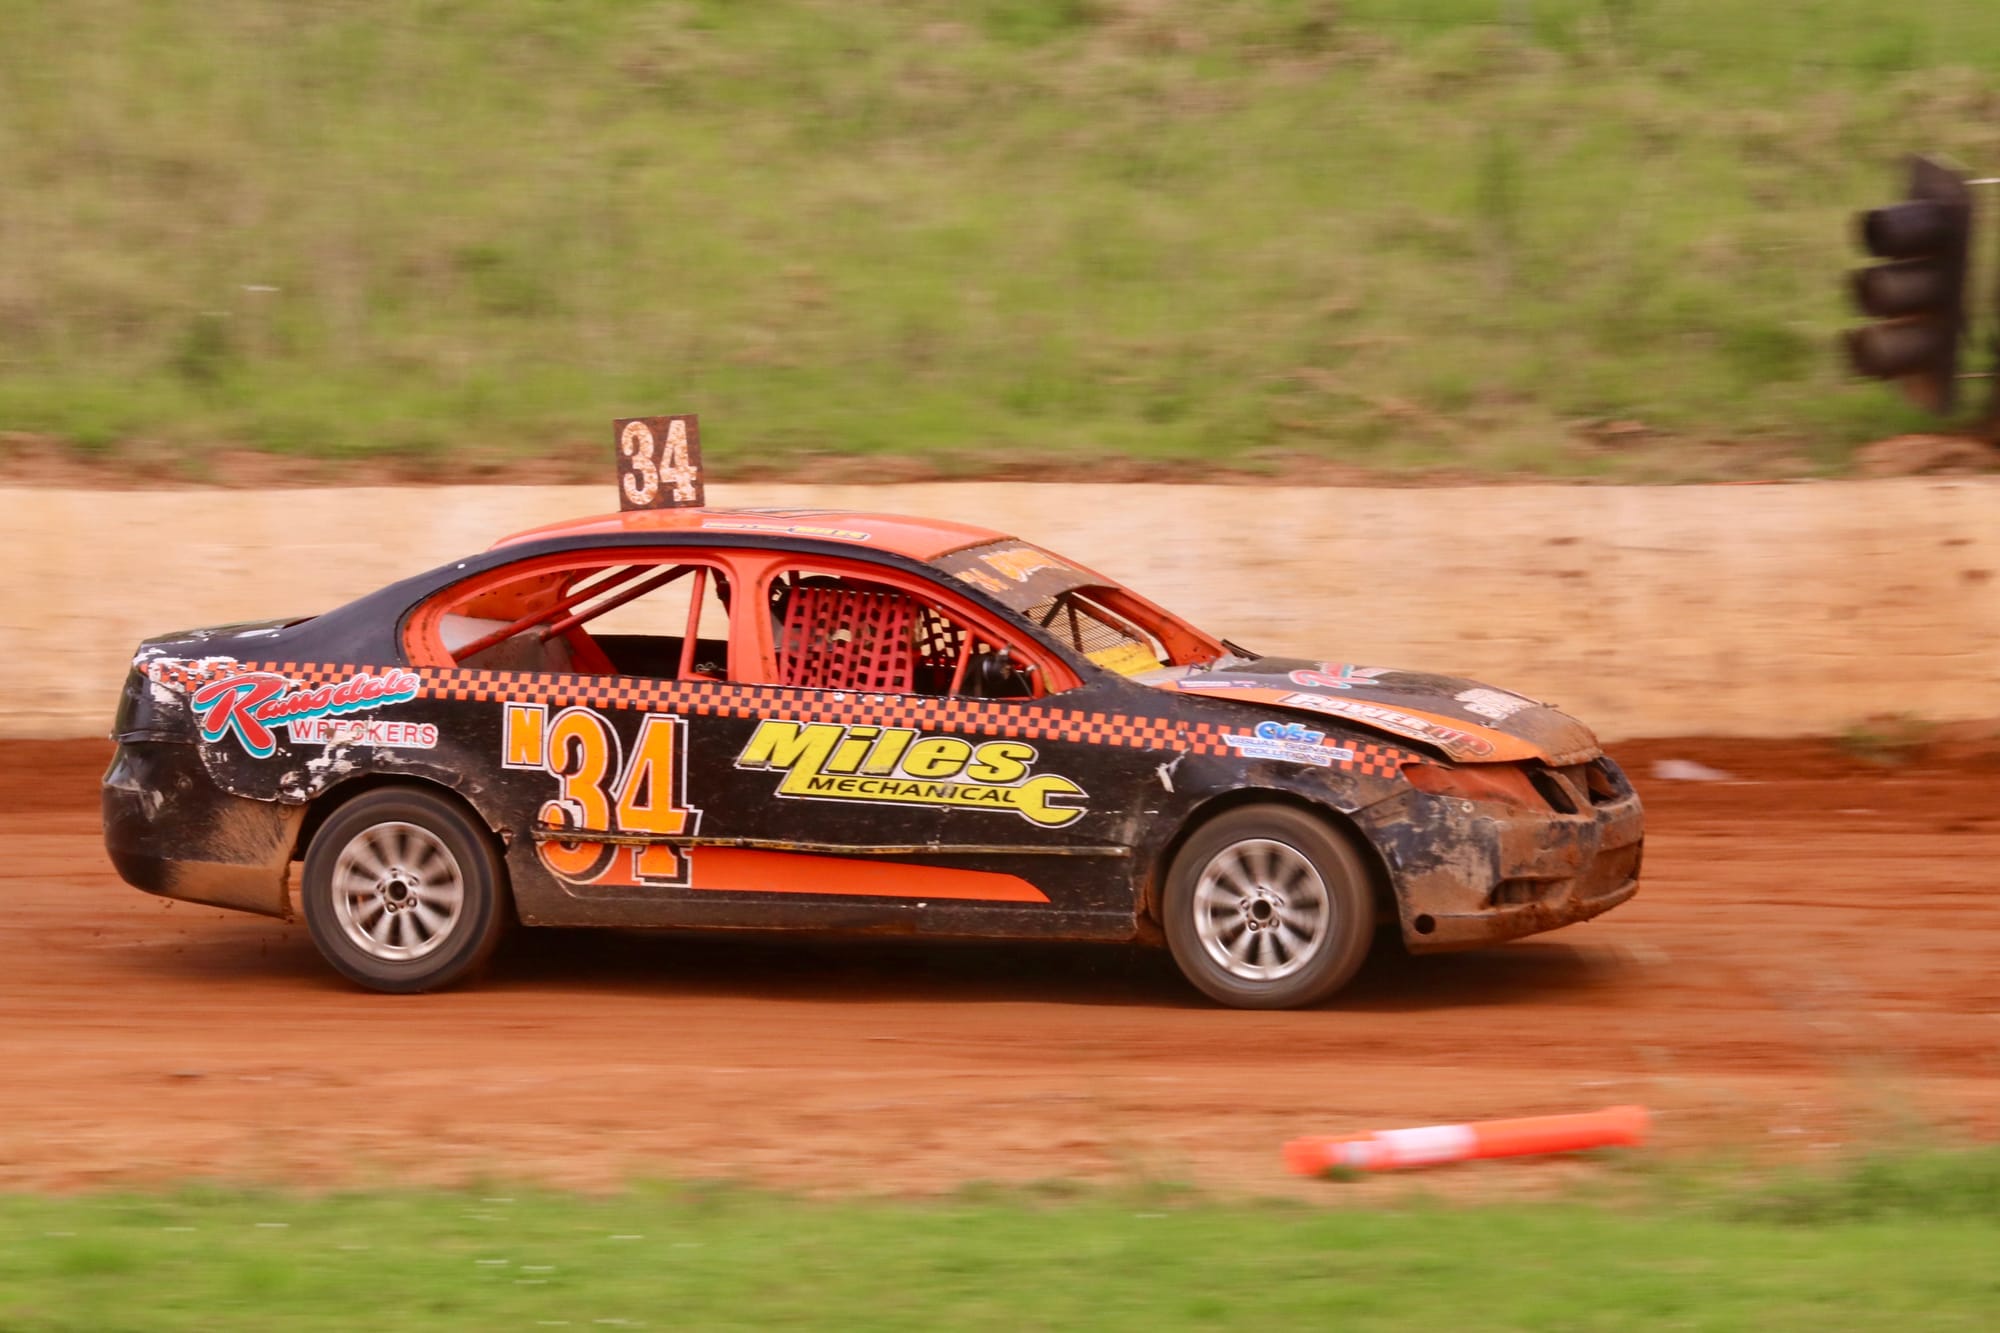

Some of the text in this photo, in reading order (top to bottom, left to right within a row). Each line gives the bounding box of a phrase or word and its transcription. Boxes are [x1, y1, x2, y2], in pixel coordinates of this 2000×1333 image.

[621, 419, 698, 505] 34
[194, 671, 421, 757] Ramsdale
[736, 720, 1036, 791] Miles
[807, 776, 1017, 804] MECHANICAL
